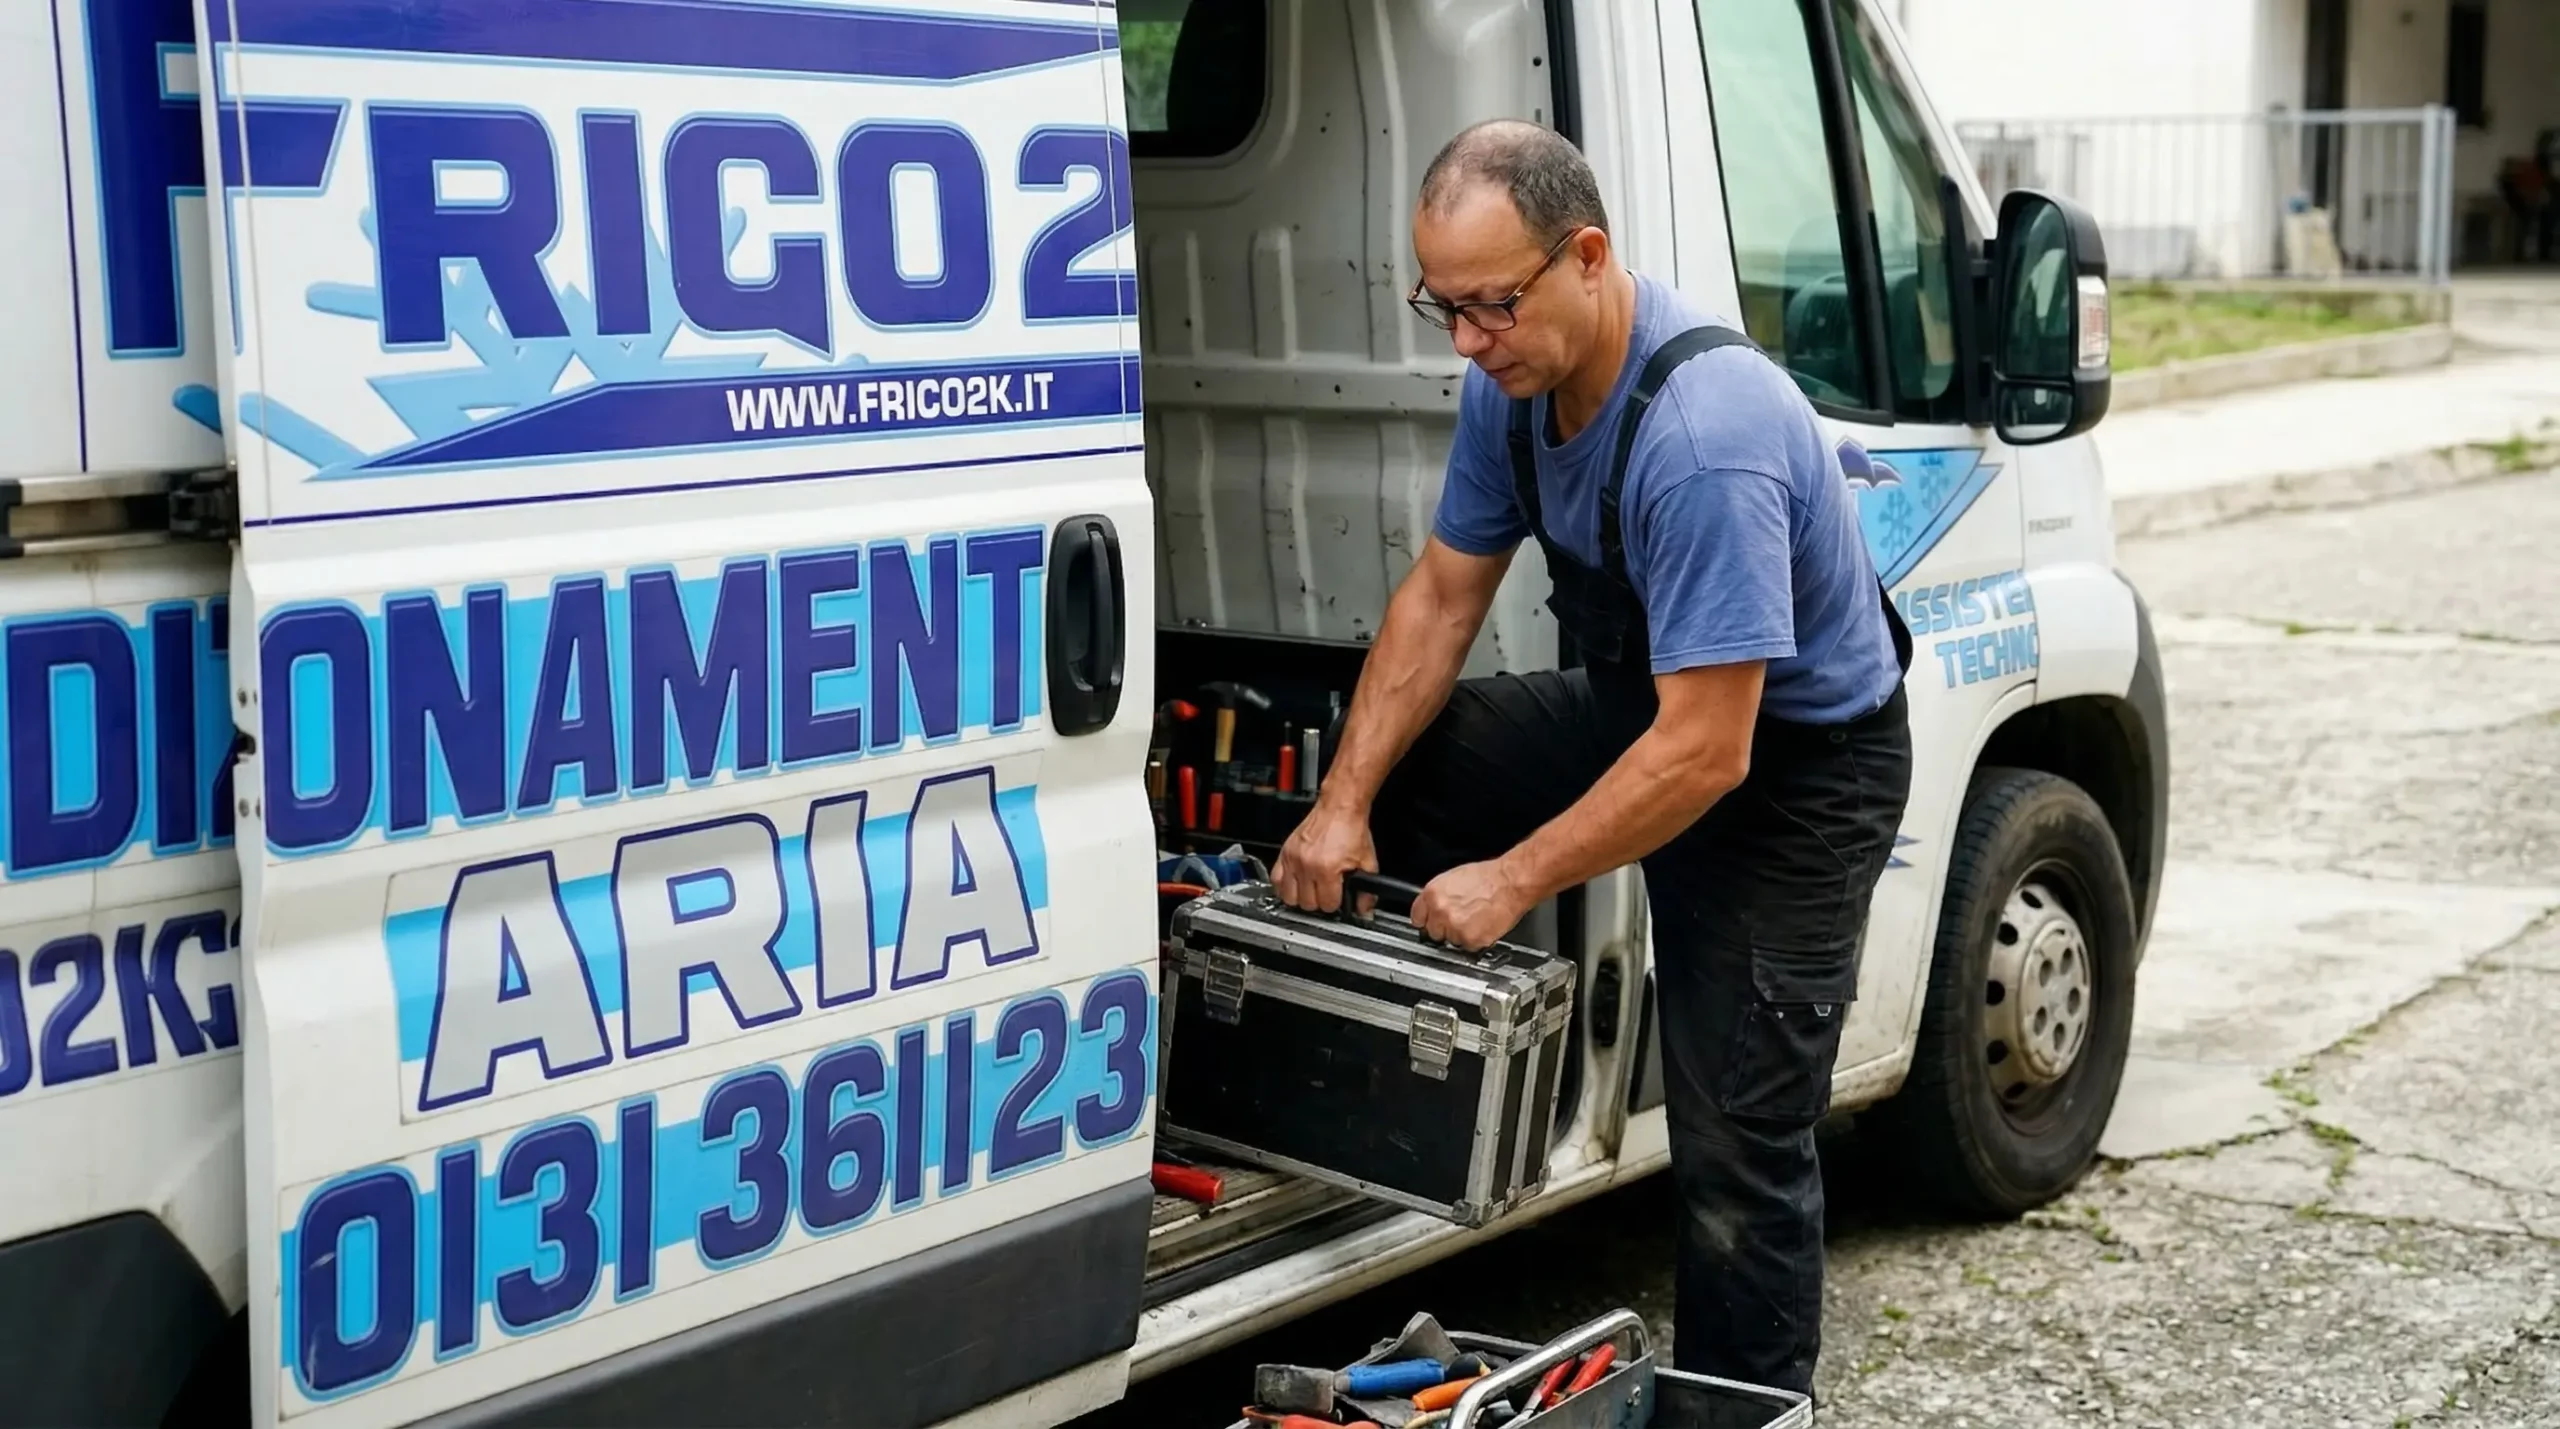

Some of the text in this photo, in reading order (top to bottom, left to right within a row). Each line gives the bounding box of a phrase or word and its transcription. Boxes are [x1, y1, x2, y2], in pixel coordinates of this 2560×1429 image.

[726, 372, 1054, 432] WWW.FRICO2K.IT
[259, 524, 1047, 857] ONAMENT
[418, 765, 1040, 1112] ARIA
[292, 966, 1157, 1402] 0131 361123
